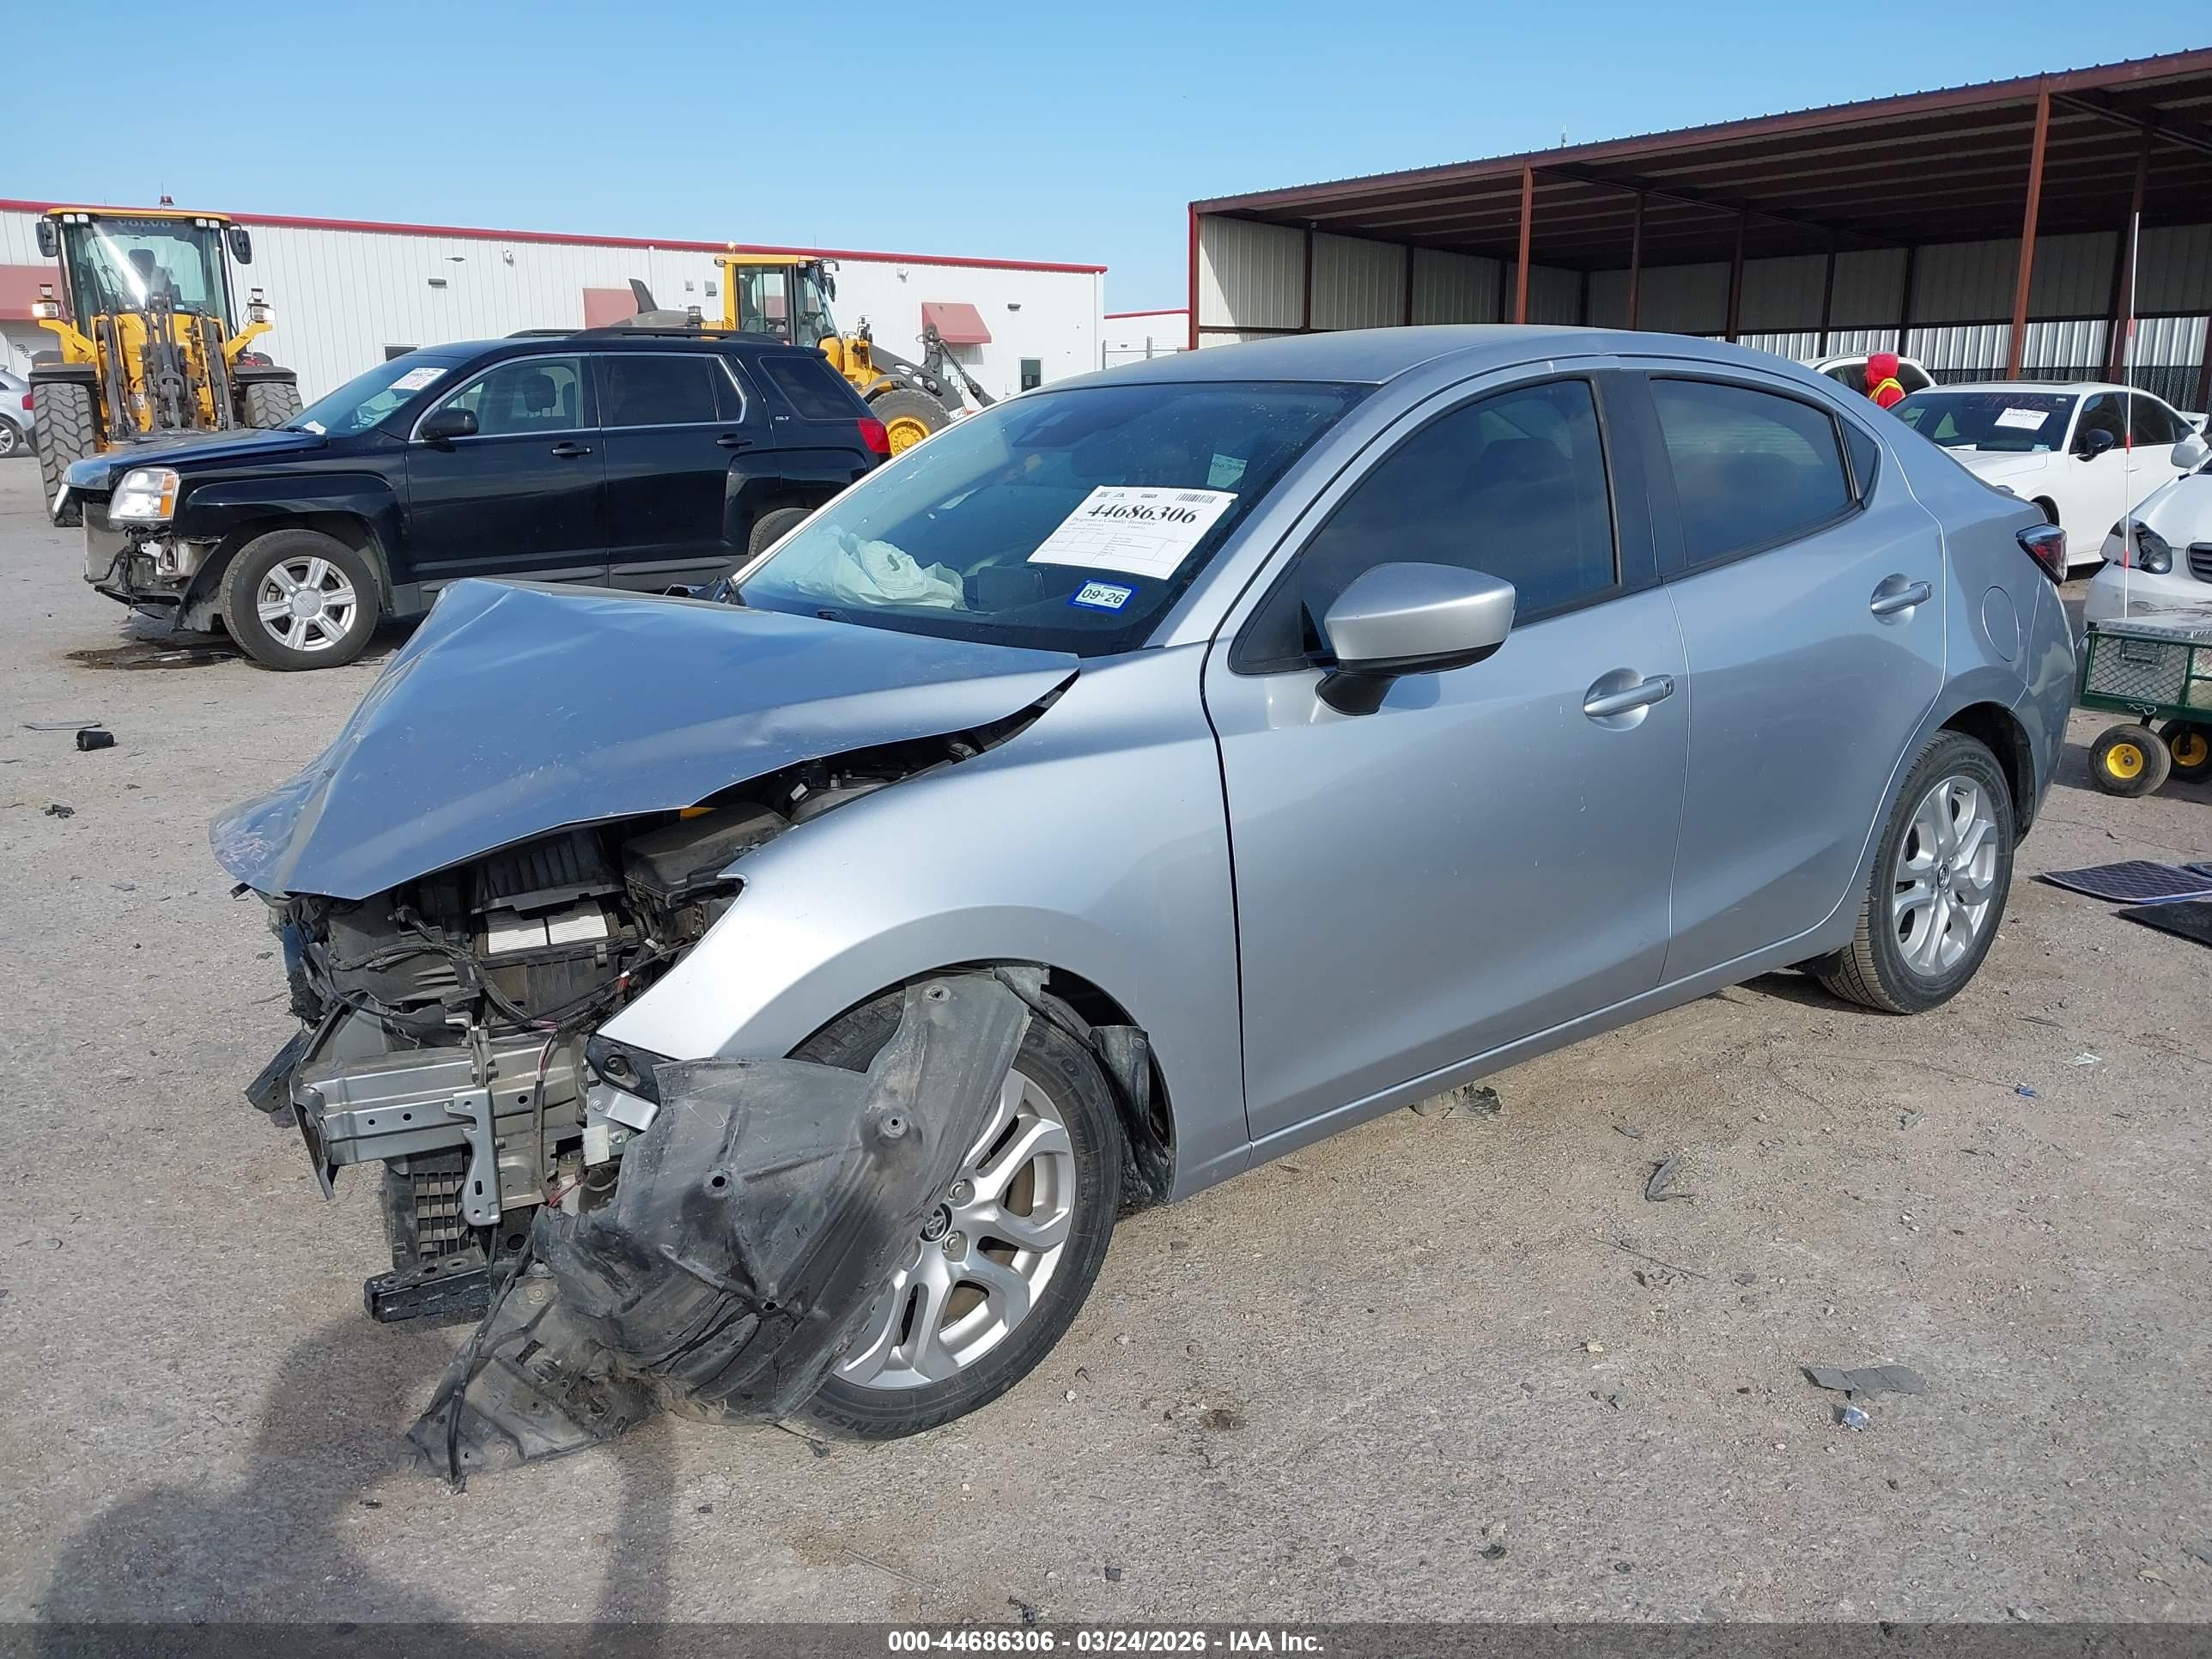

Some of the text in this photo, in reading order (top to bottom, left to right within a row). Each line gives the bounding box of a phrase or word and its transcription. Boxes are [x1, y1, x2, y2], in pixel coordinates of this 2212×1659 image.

[116, 219, 172, 228] VOLVO
[1087, 503, 1202, 524] 44686306
[1081, 588, 1101, 599] 09
[1104, 592, 1125, 604] 26
